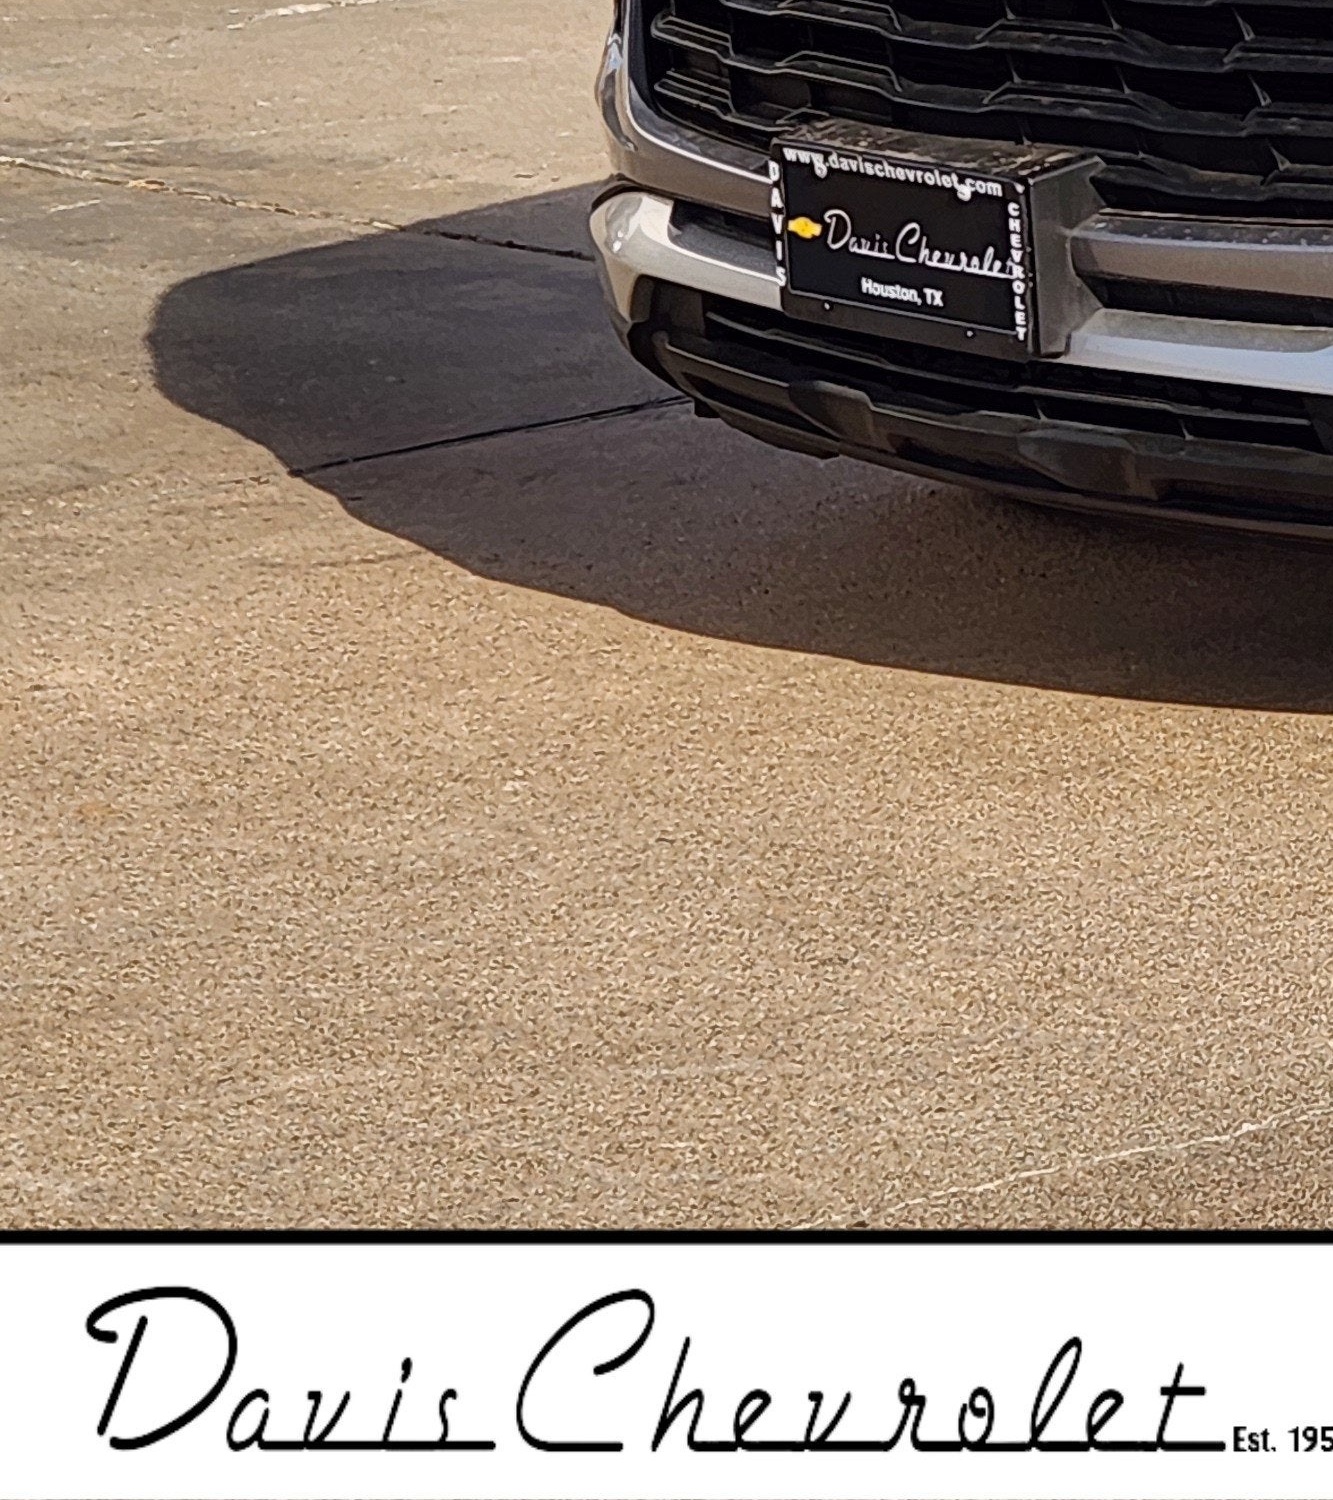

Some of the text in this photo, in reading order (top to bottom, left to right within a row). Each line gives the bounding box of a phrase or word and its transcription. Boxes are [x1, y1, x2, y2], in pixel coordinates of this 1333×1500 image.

[782, 147, 1003, 199] www.davischevrolet.com
[768, 160, 786, 287] DAVIS
[824, 209, 895, 260] Davis
[861, 277, 944, 307] Houston, TX
[1007, 202, 1027, 341] CHEVROLET
